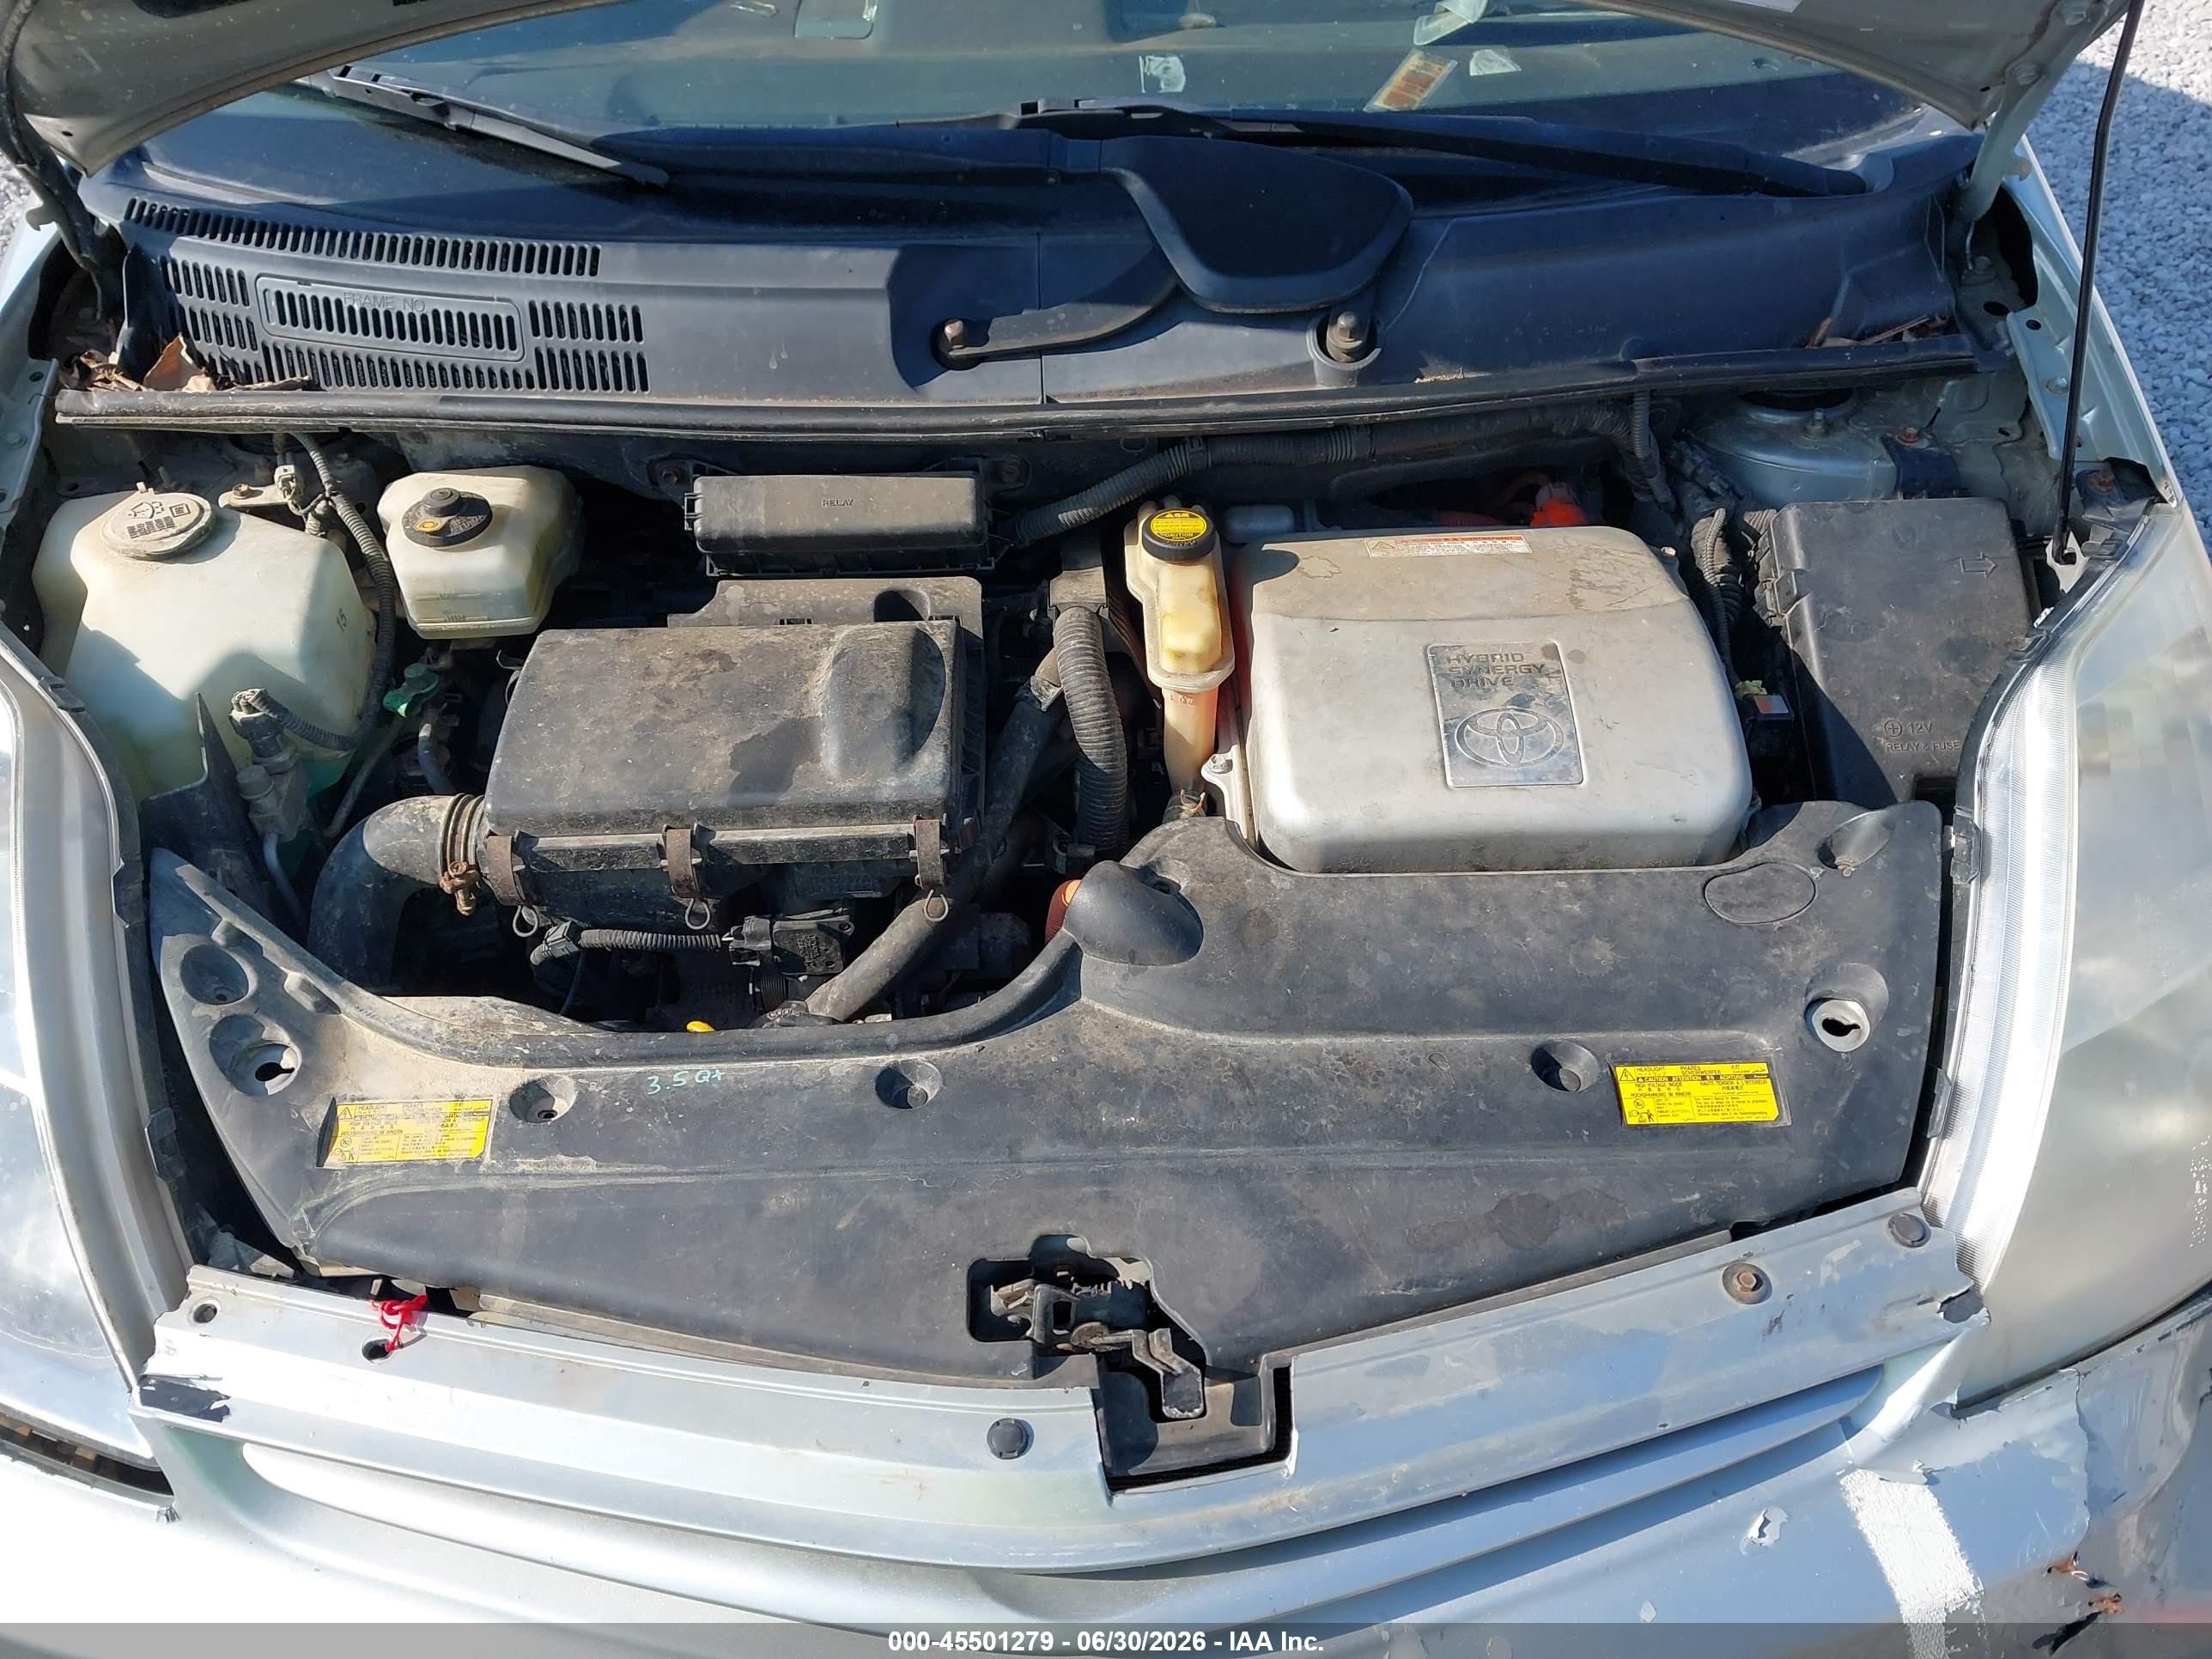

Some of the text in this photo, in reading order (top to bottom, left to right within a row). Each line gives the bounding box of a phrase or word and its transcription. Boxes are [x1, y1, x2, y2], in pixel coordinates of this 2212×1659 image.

[343, 292, 395, 309] FRAME
[1446, 653, 1524, 664] HYBRID
[1448, 664, 1546, 675] SYNERGY
[1450, 676, 1515, 688] DRIVE
[1907, 721, 1933, 734] 12V
[1886, 741, 1920, 751] RELAY
[1932, 740, 1960, 750] FUSE
[645, 1071, 689, 1095] 3.5
